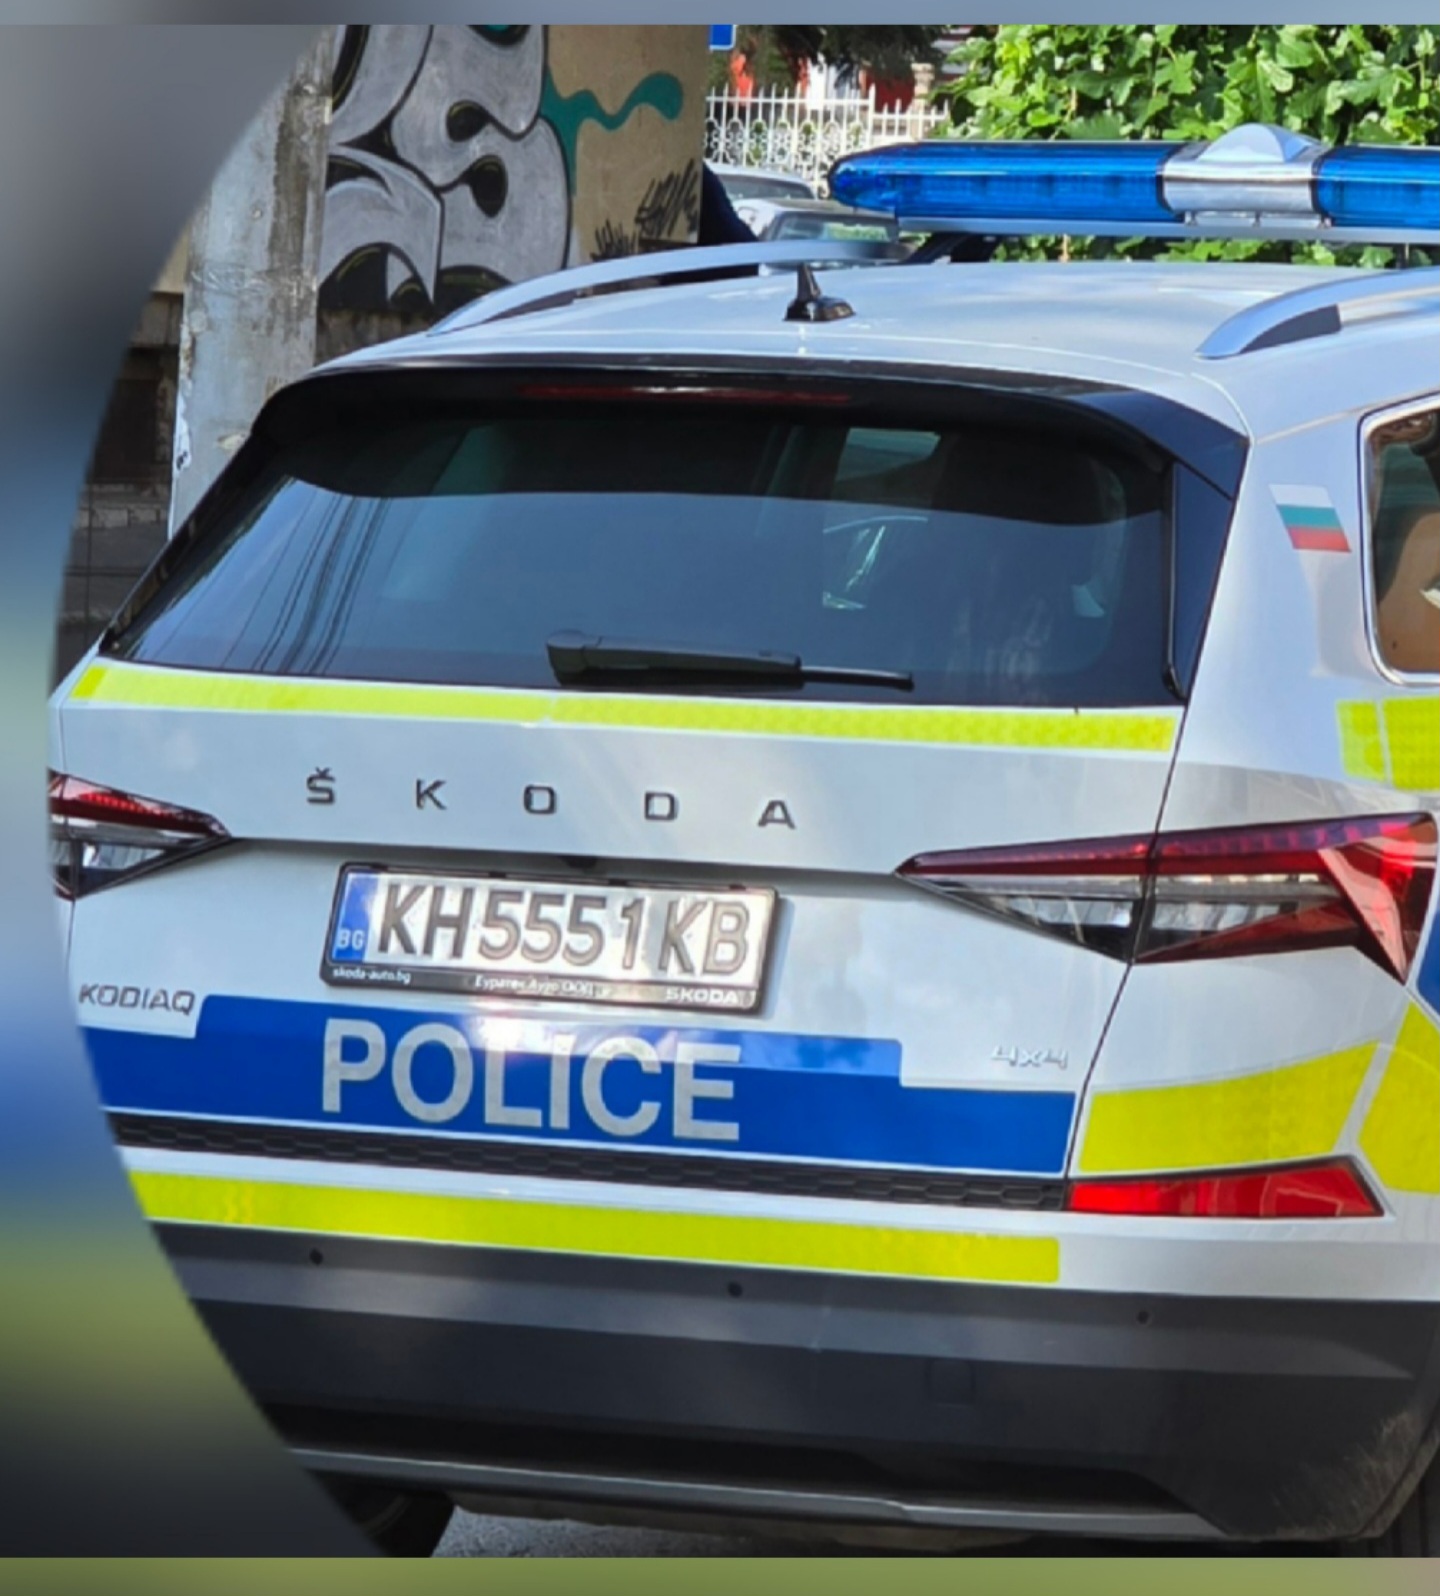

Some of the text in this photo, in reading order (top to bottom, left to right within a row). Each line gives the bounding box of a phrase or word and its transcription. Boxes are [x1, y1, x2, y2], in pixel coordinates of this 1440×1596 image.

[306, 767, 796, 829] ŠKODA
[336, 928, 364, 951] BG
[79, 984, 195, 1016] KODIAQ
[321, 1018, 740, 1142] POLICE
